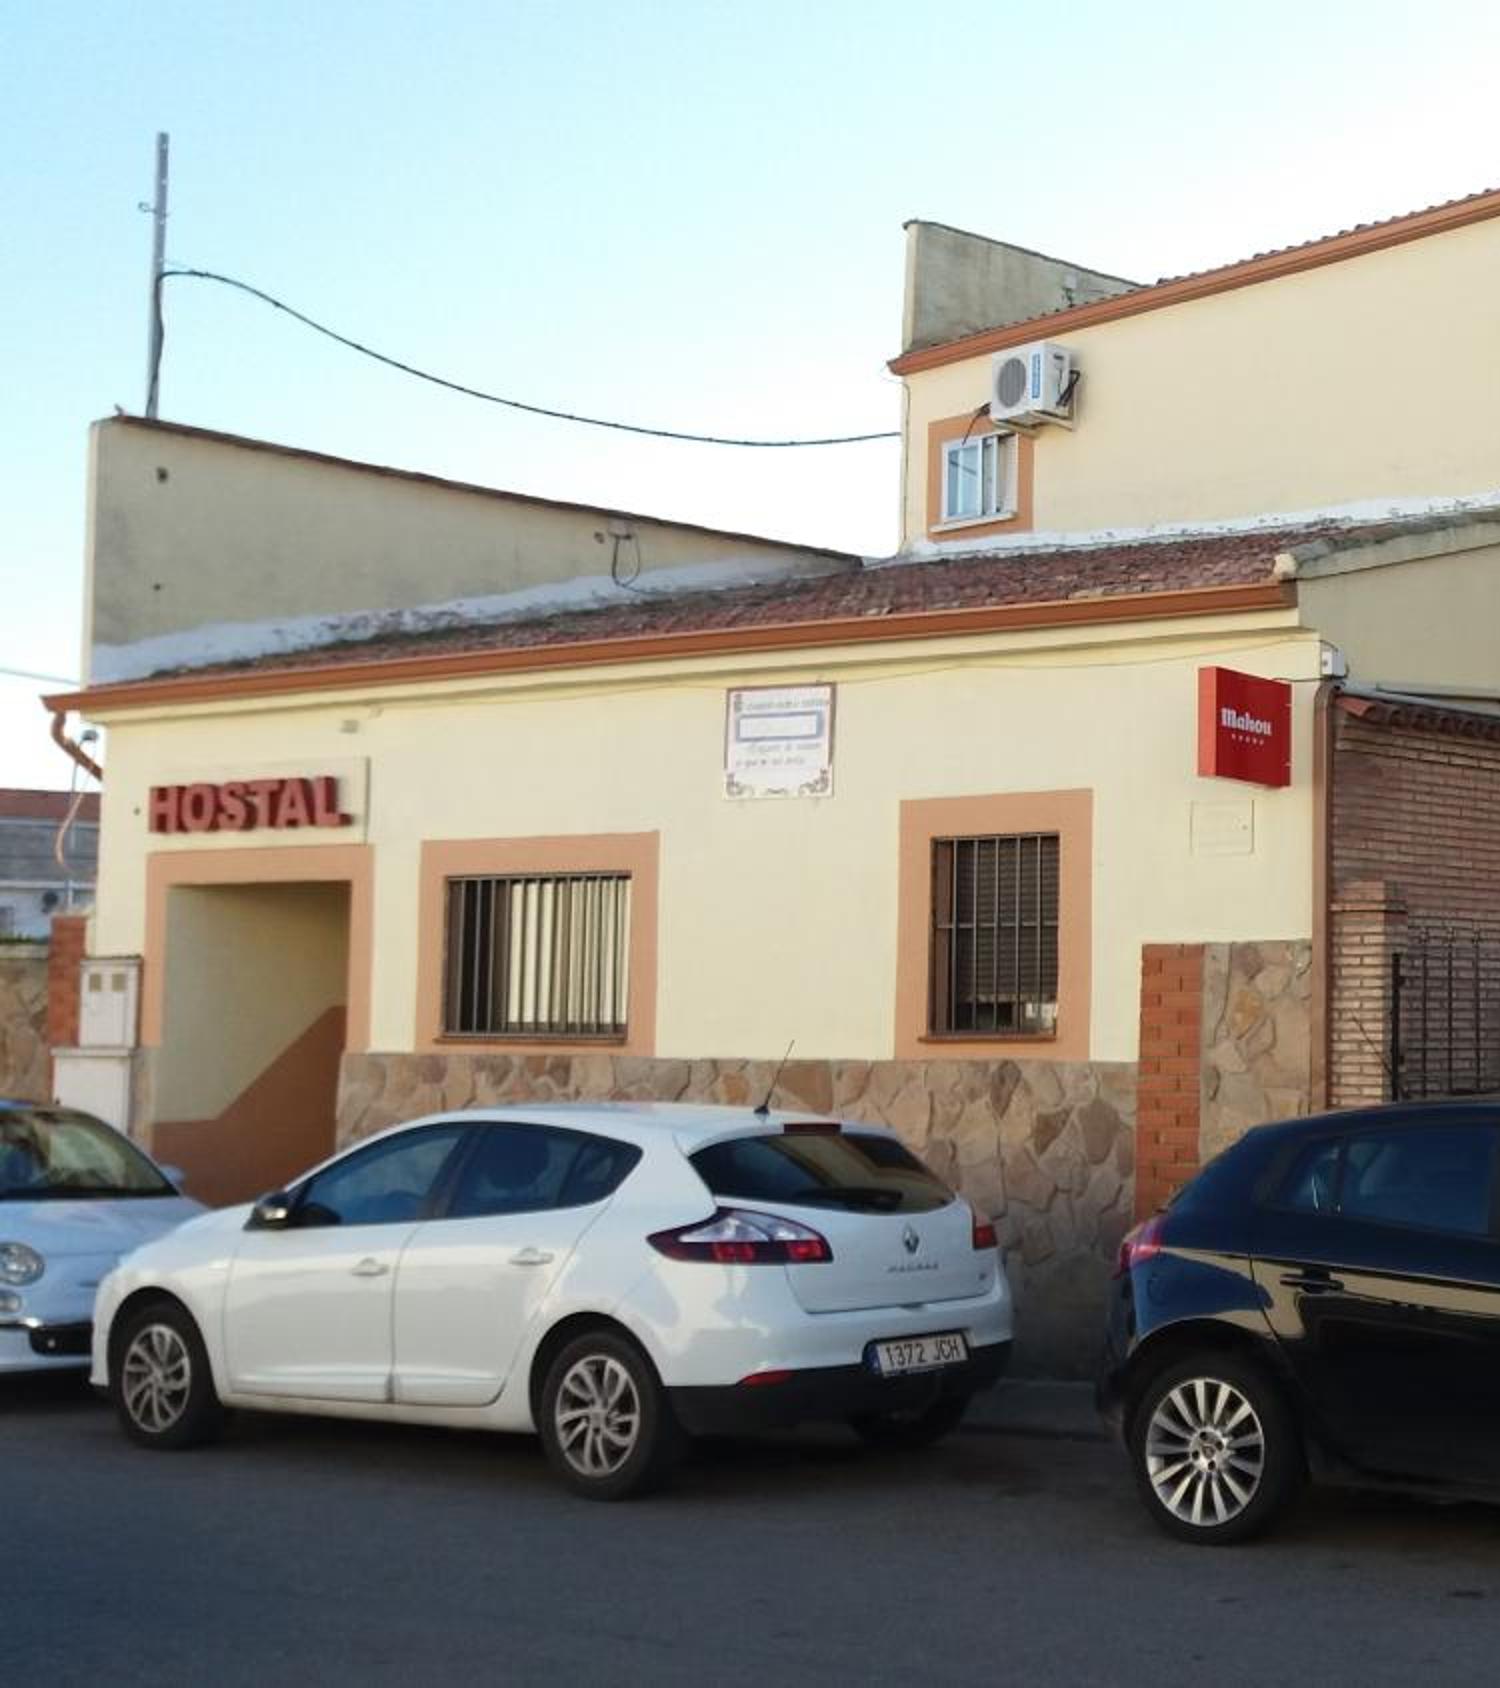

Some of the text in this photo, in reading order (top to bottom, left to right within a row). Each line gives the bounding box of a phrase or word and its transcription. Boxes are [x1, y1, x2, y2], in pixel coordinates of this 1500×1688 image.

[1221, 707, 1272, 735] Mahou
[149, 777, 354, 833] HOSTAL
[885, 1338, 961, 1368] 1372 JCH
